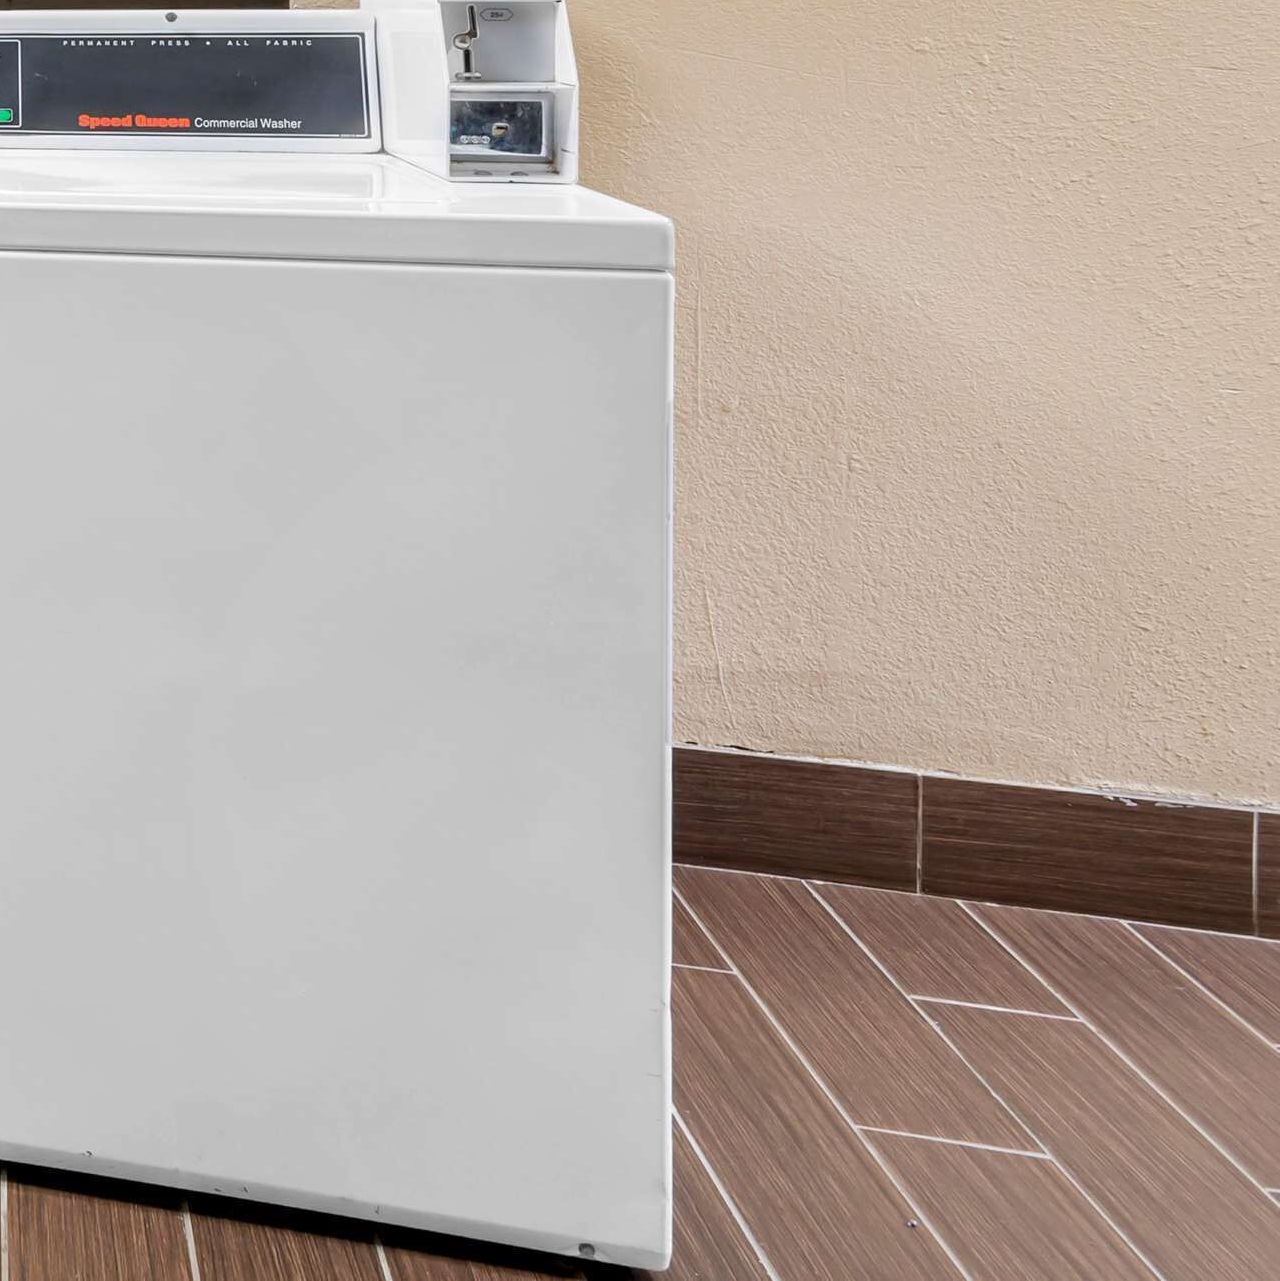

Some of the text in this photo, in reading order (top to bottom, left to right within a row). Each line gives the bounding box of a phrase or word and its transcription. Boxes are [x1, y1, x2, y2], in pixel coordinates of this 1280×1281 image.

[78, 114, 302, 129] Speed Queen Commercial Washer
